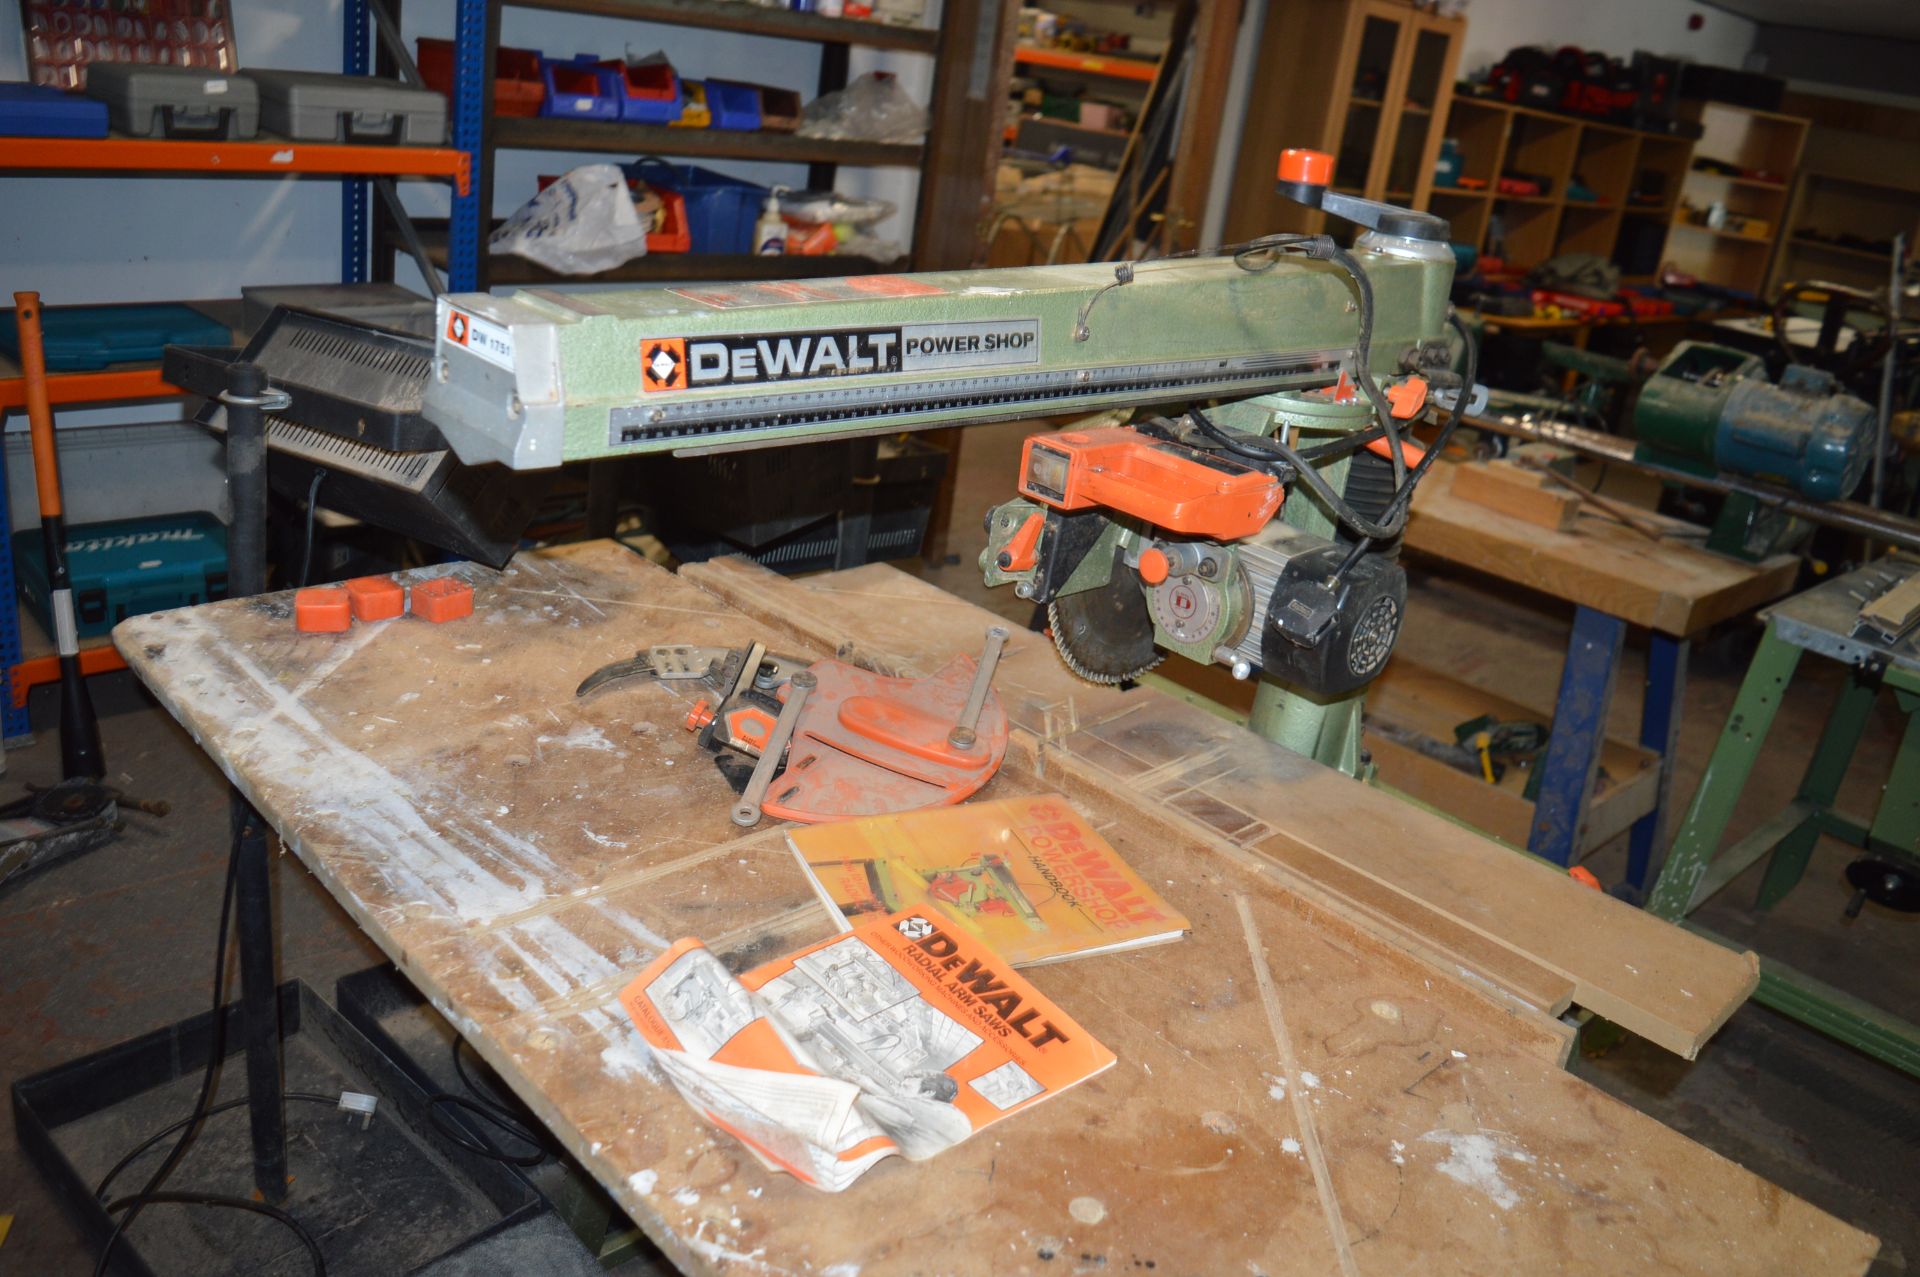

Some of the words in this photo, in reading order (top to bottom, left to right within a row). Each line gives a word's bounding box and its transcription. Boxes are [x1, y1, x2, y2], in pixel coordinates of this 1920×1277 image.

[471, 329, 487, 345] DW
[490, 339, 511, 357] 1751
[906, 335, 980, 354] POWER
[984, 332, 1035, 350] SHOP
[1024, 825, 1131, 928] POWERSHOP
[1029, 856, 1081, 908] HANDBOOK
[903, 944, 949, 983] RADIAL
[945, 983, 977, 1010] ARM
[973, 1005, 1012, 1037] SAWS
